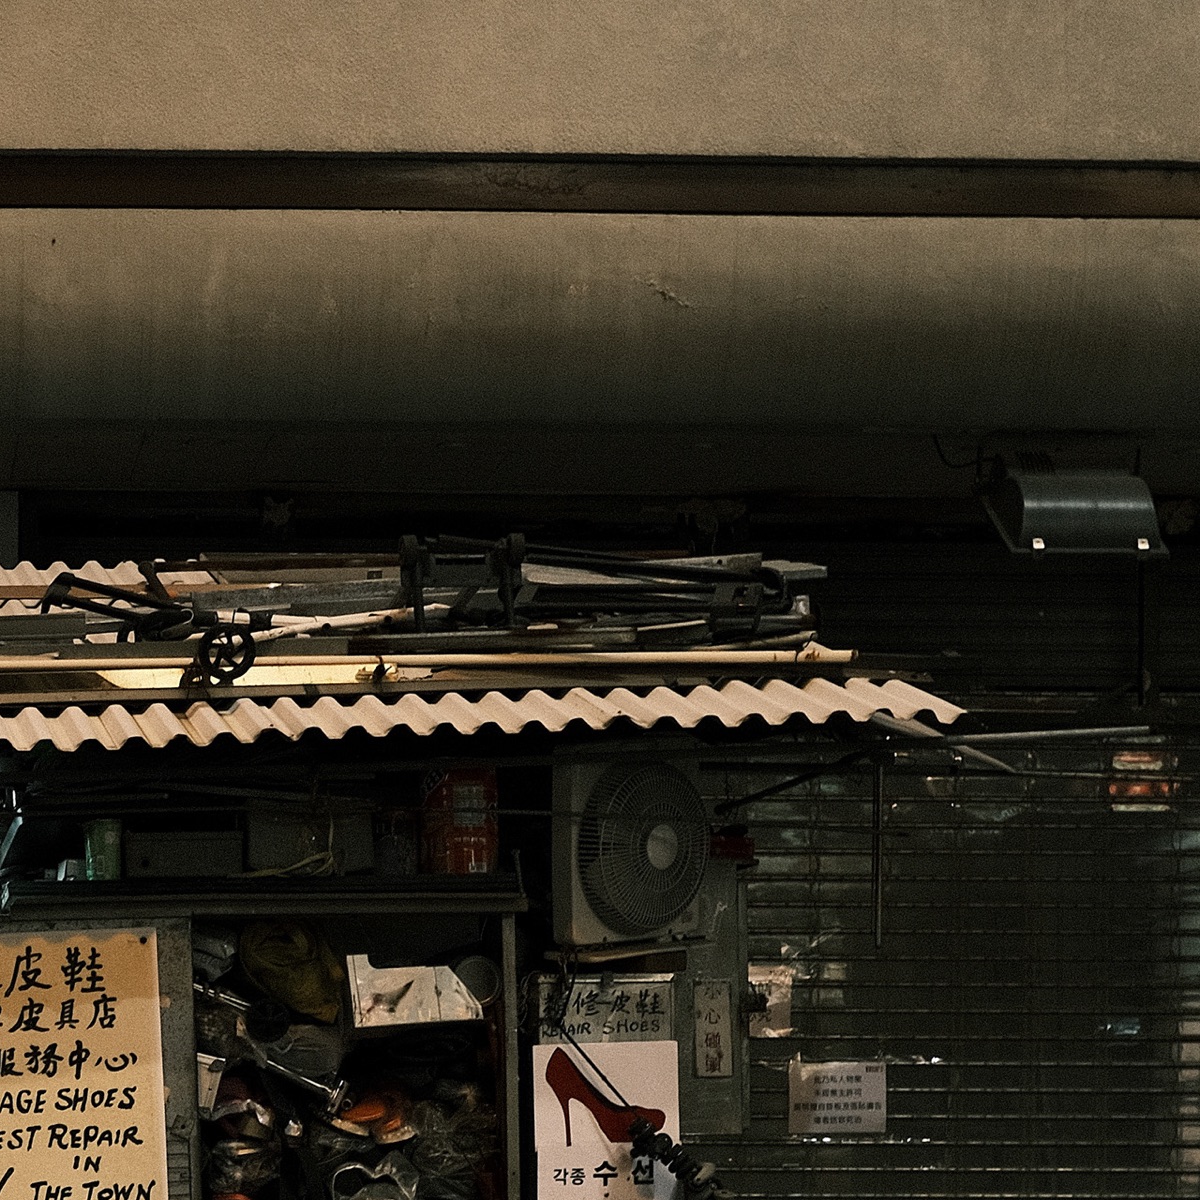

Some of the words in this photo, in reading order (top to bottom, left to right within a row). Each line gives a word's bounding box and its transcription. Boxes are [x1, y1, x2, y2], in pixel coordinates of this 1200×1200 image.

[602, 1018, 660, 1035] SHOES
[55, 1086, 137, 1110] SHOES
[47, 1123, 143, 1151] REPAIR
[74, 1155, 101, 1173] IN
[553, 1168, 586, 1186] 각종
